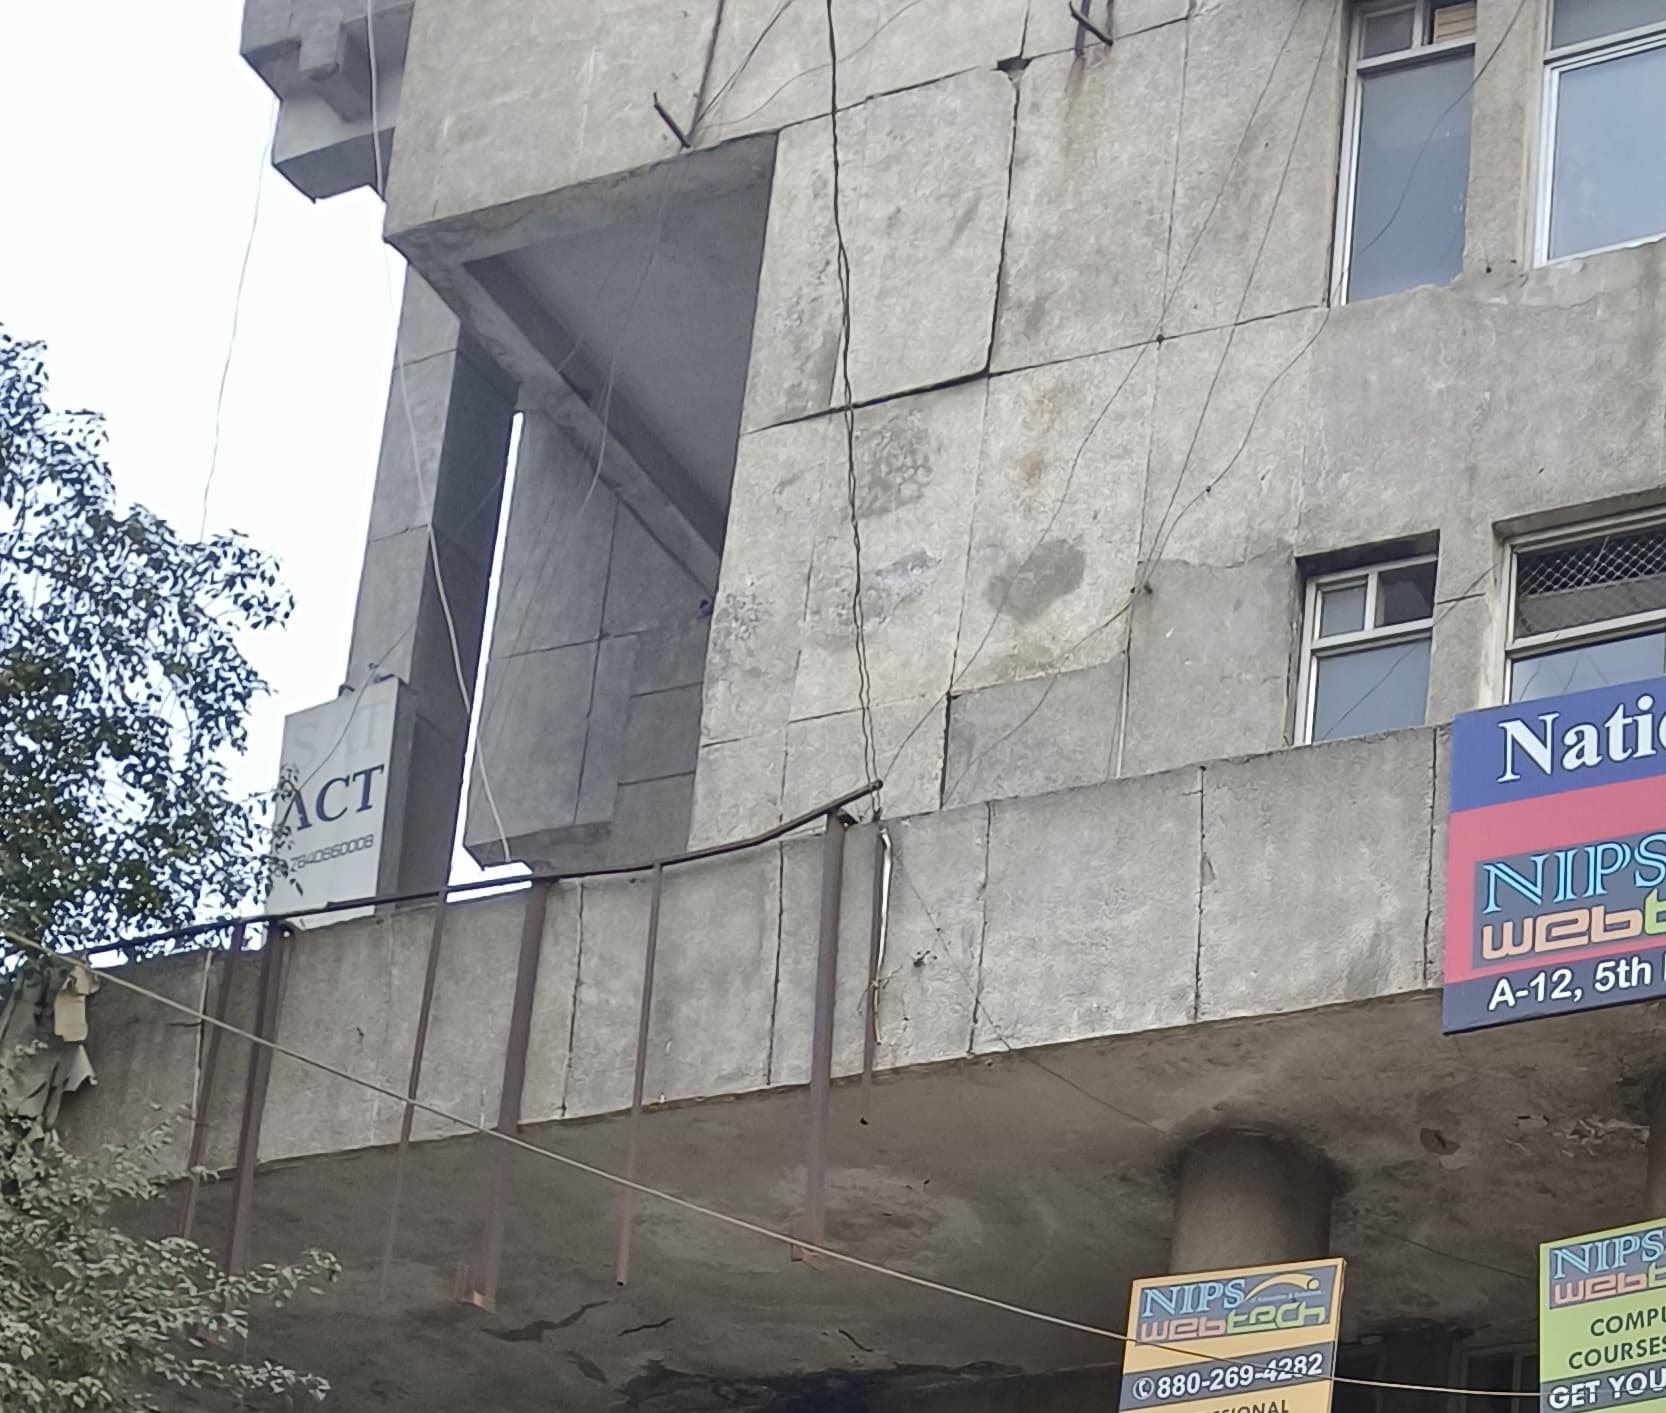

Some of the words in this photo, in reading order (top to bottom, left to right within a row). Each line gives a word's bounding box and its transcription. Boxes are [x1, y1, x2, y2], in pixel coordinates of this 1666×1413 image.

[1487, 969, 1582, 1011] A-12,
[1594, 956, 1652, 991] 5th
[1157, 1353, 1323, 1399] 880-269-4282
